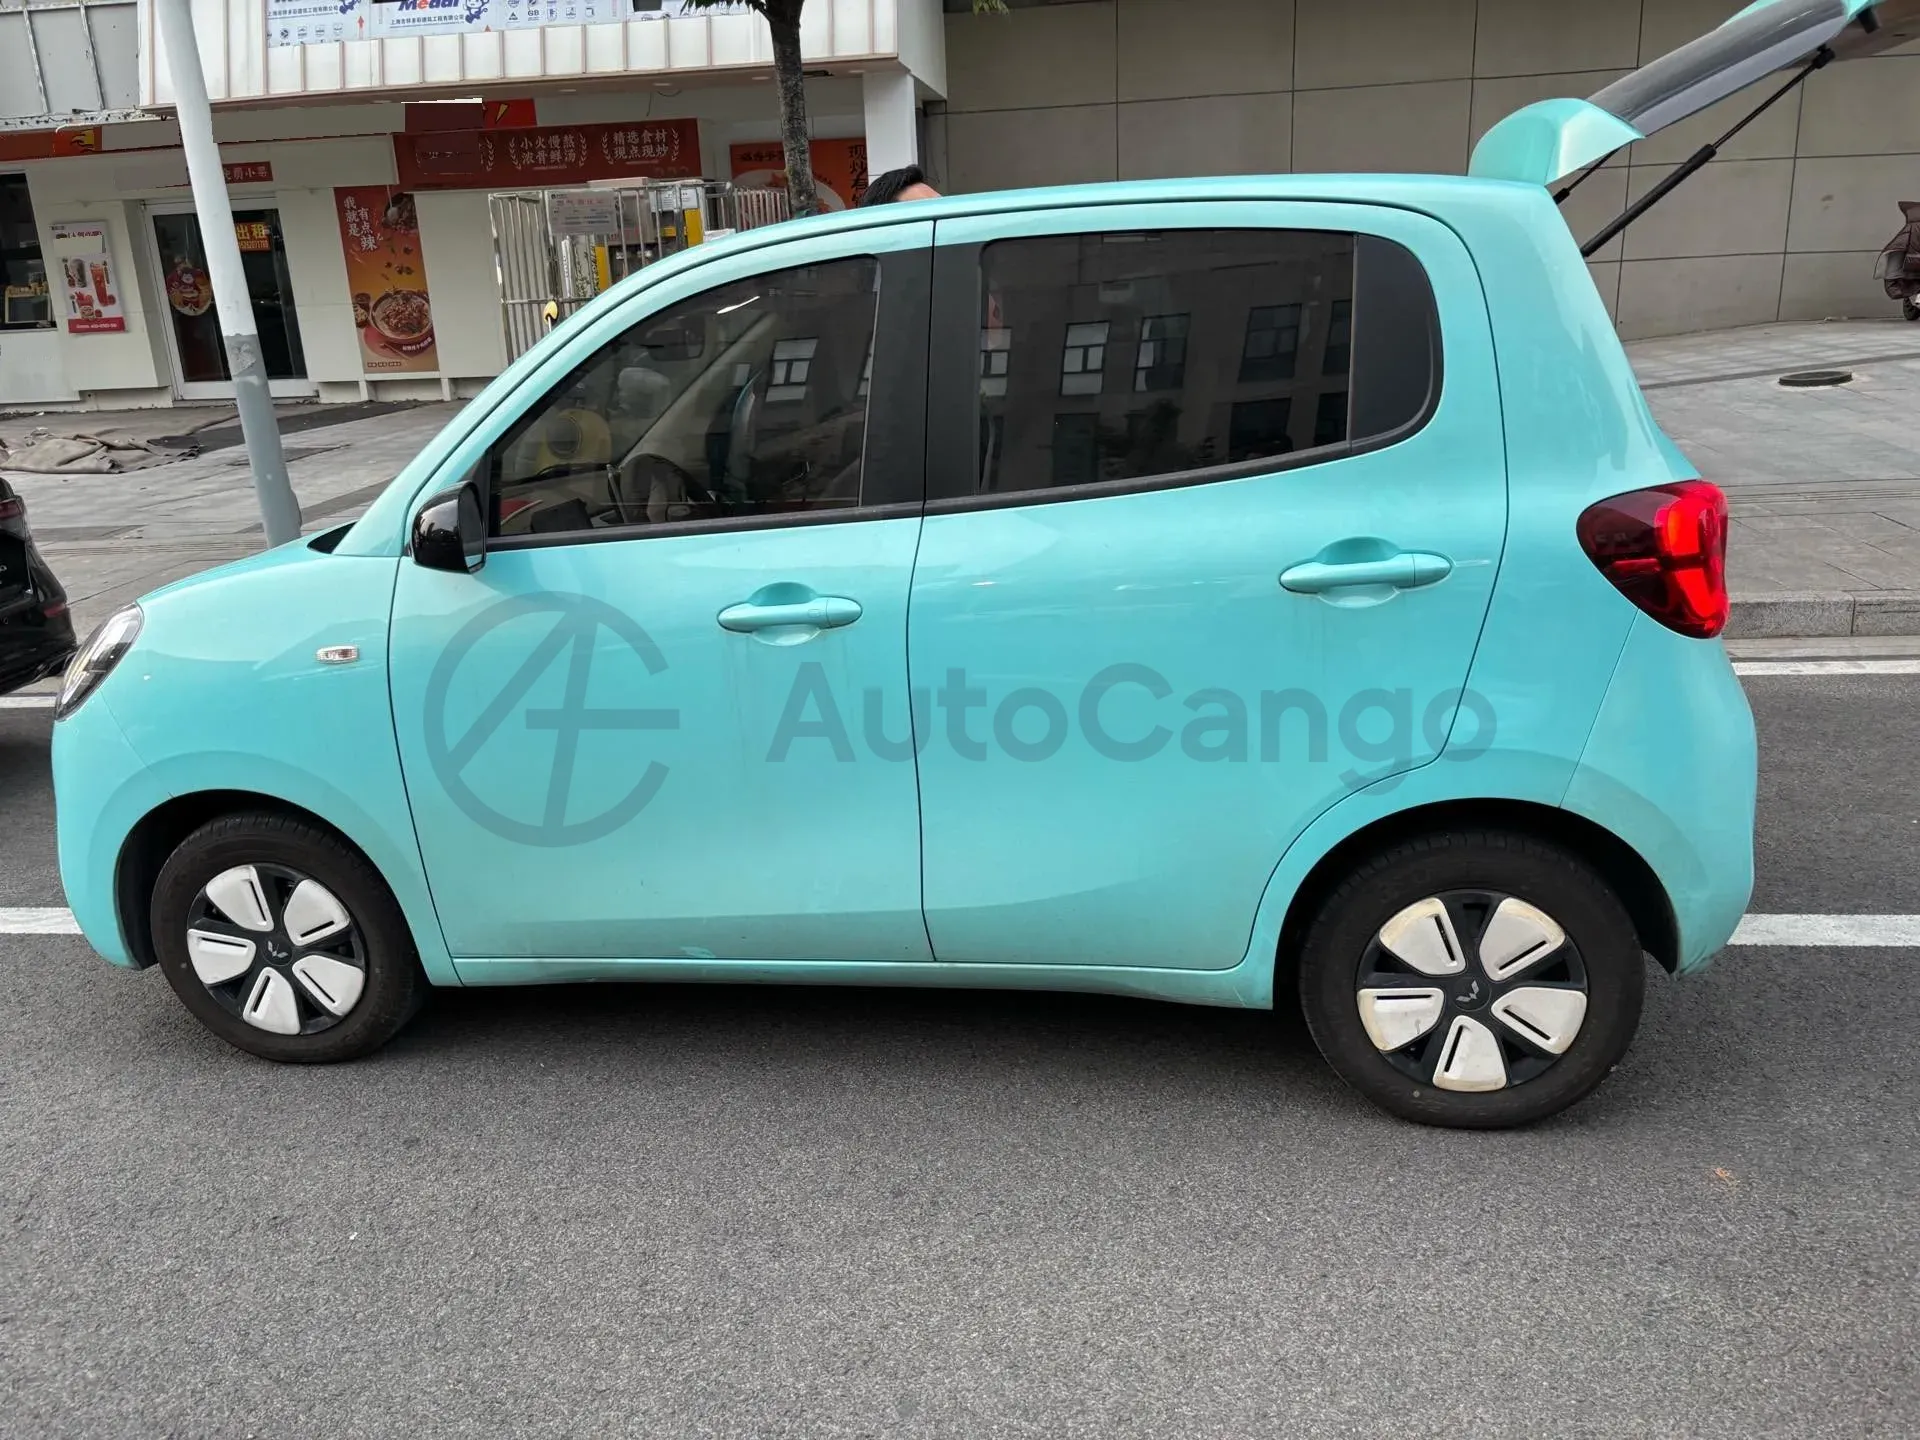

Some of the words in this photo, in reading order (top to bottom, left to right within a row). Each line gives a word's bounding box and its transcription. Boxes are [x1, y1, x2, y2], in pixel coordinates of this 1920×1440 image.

[519, 134, 576, 150] 小火慢熬
[613, 129, 668, 145] 精选食材
[521, 149, 577, 165] 浓骨鲜汤
[343, 196, 361, 238] 我就是
[236, 223, 267, 240] 出租
[358, 207, 378, 251] 有点辣
